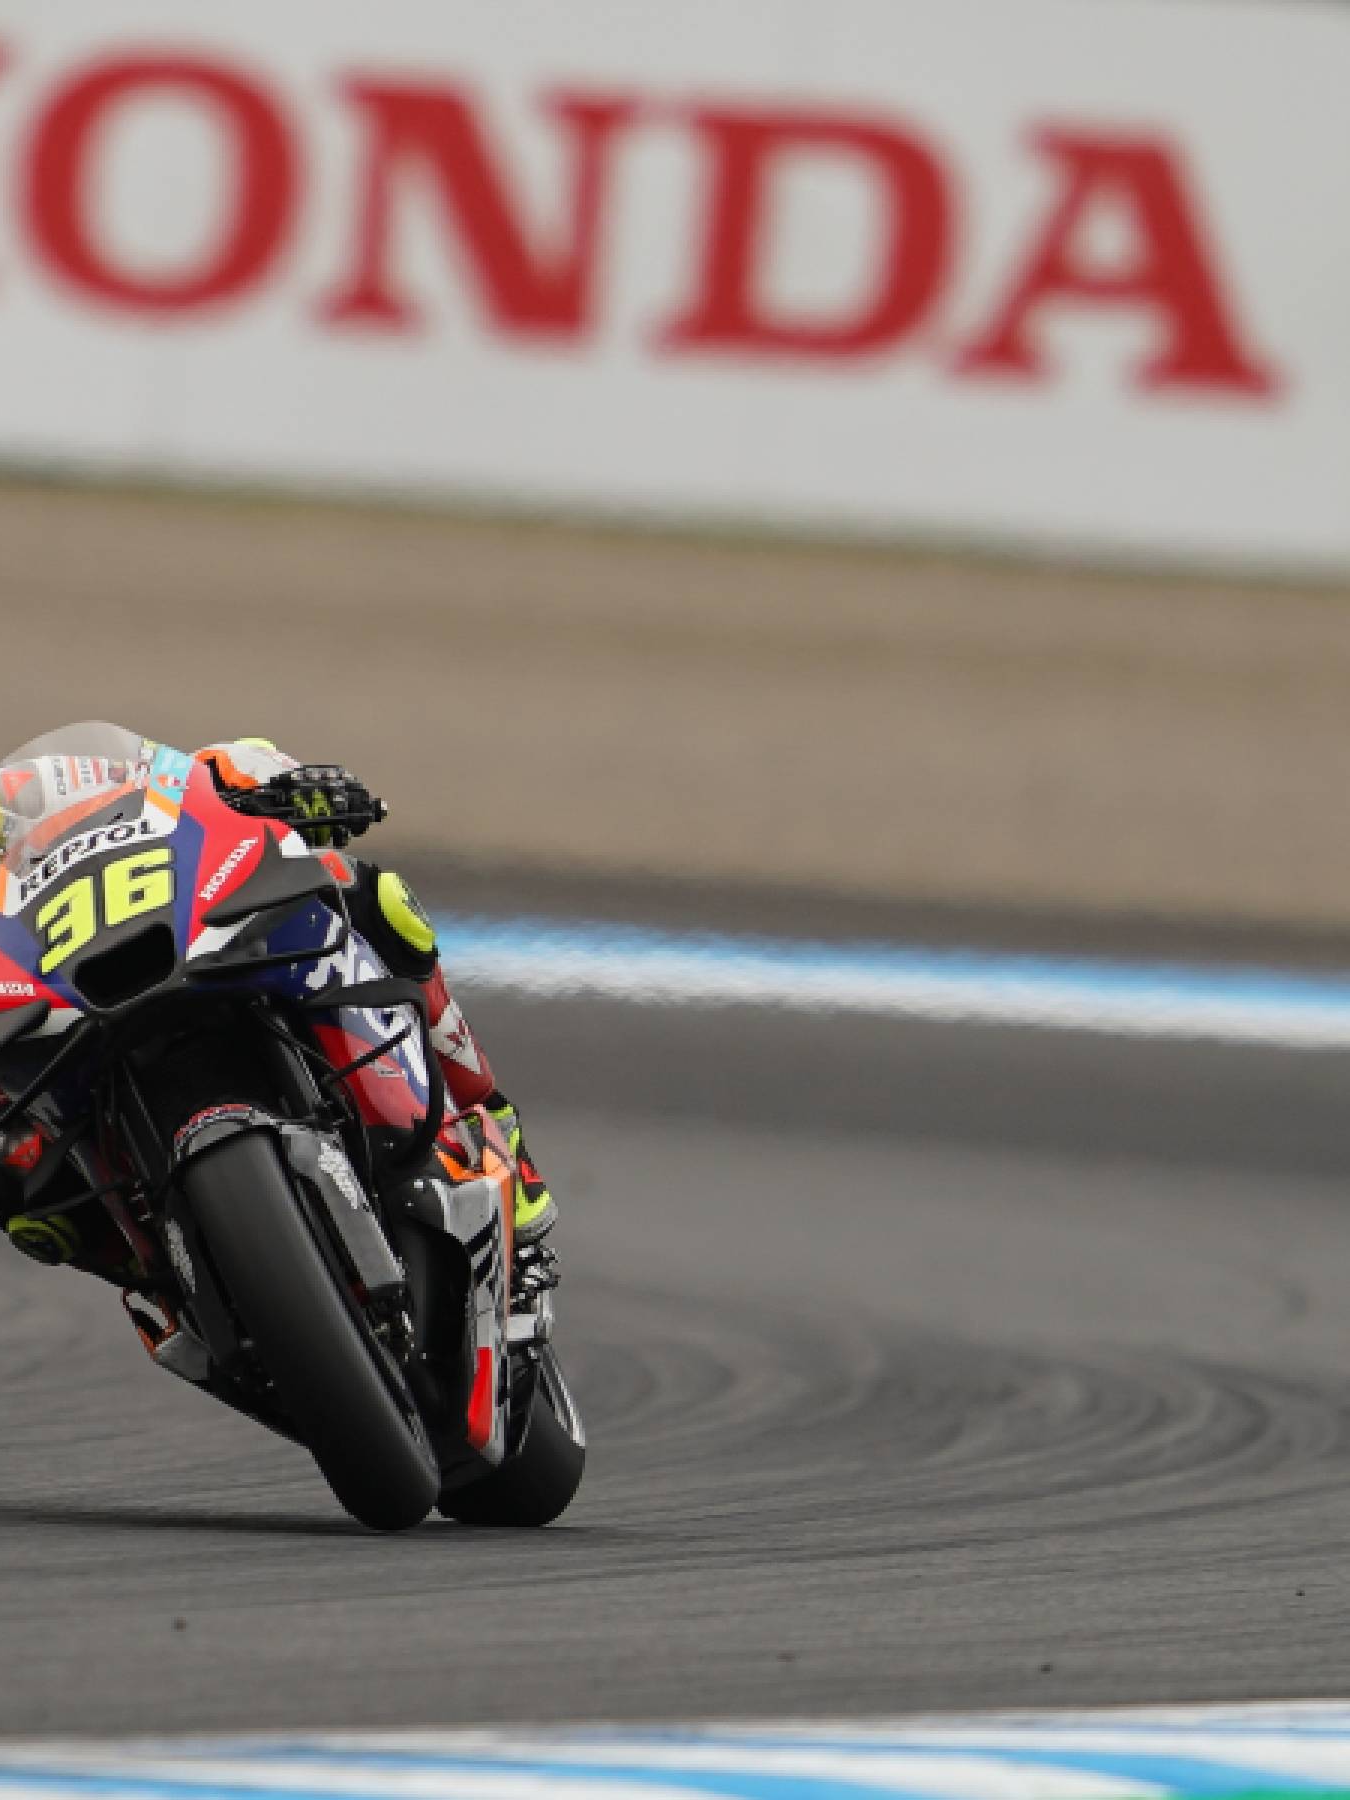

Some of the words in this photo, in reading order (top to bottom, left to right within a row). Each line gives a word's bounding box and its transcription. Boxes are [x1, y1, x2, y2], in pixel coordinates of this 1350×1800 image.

[19, 820, 157, 901] REPSOL
[198, 836, 260, 901] HONDA
[36, 847, 176, 975] 36
